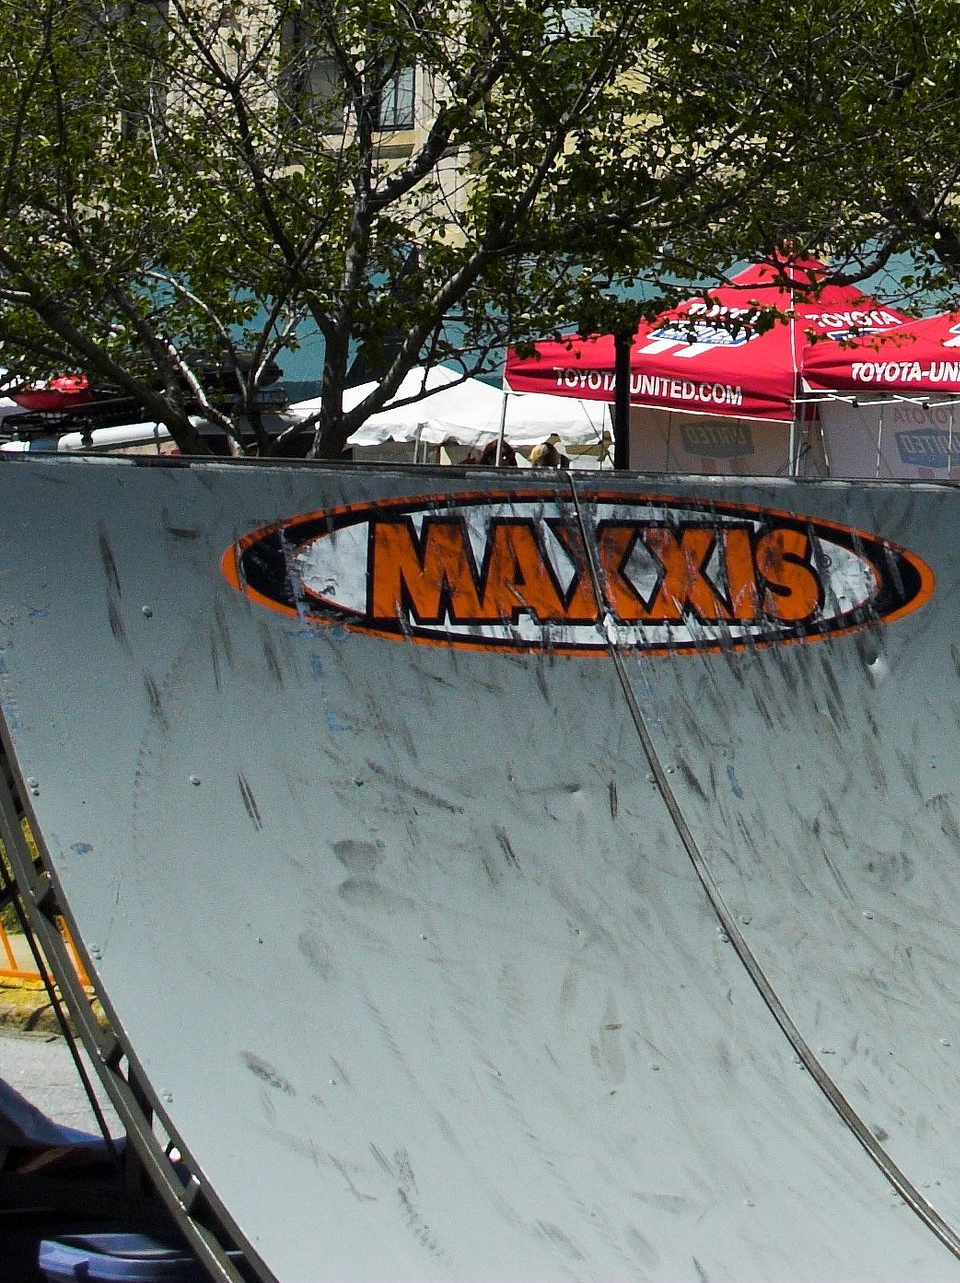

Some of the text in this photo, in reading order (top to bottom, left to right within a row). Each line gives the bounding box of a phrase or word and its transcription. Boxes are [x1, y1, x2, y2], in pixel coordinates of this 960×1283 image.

[804, 310, 903, 328] TOYOTA
[553, 367, 743, 406] TOYOTUNITED.COM
[367, 515, 826, 624] MAXXIS
